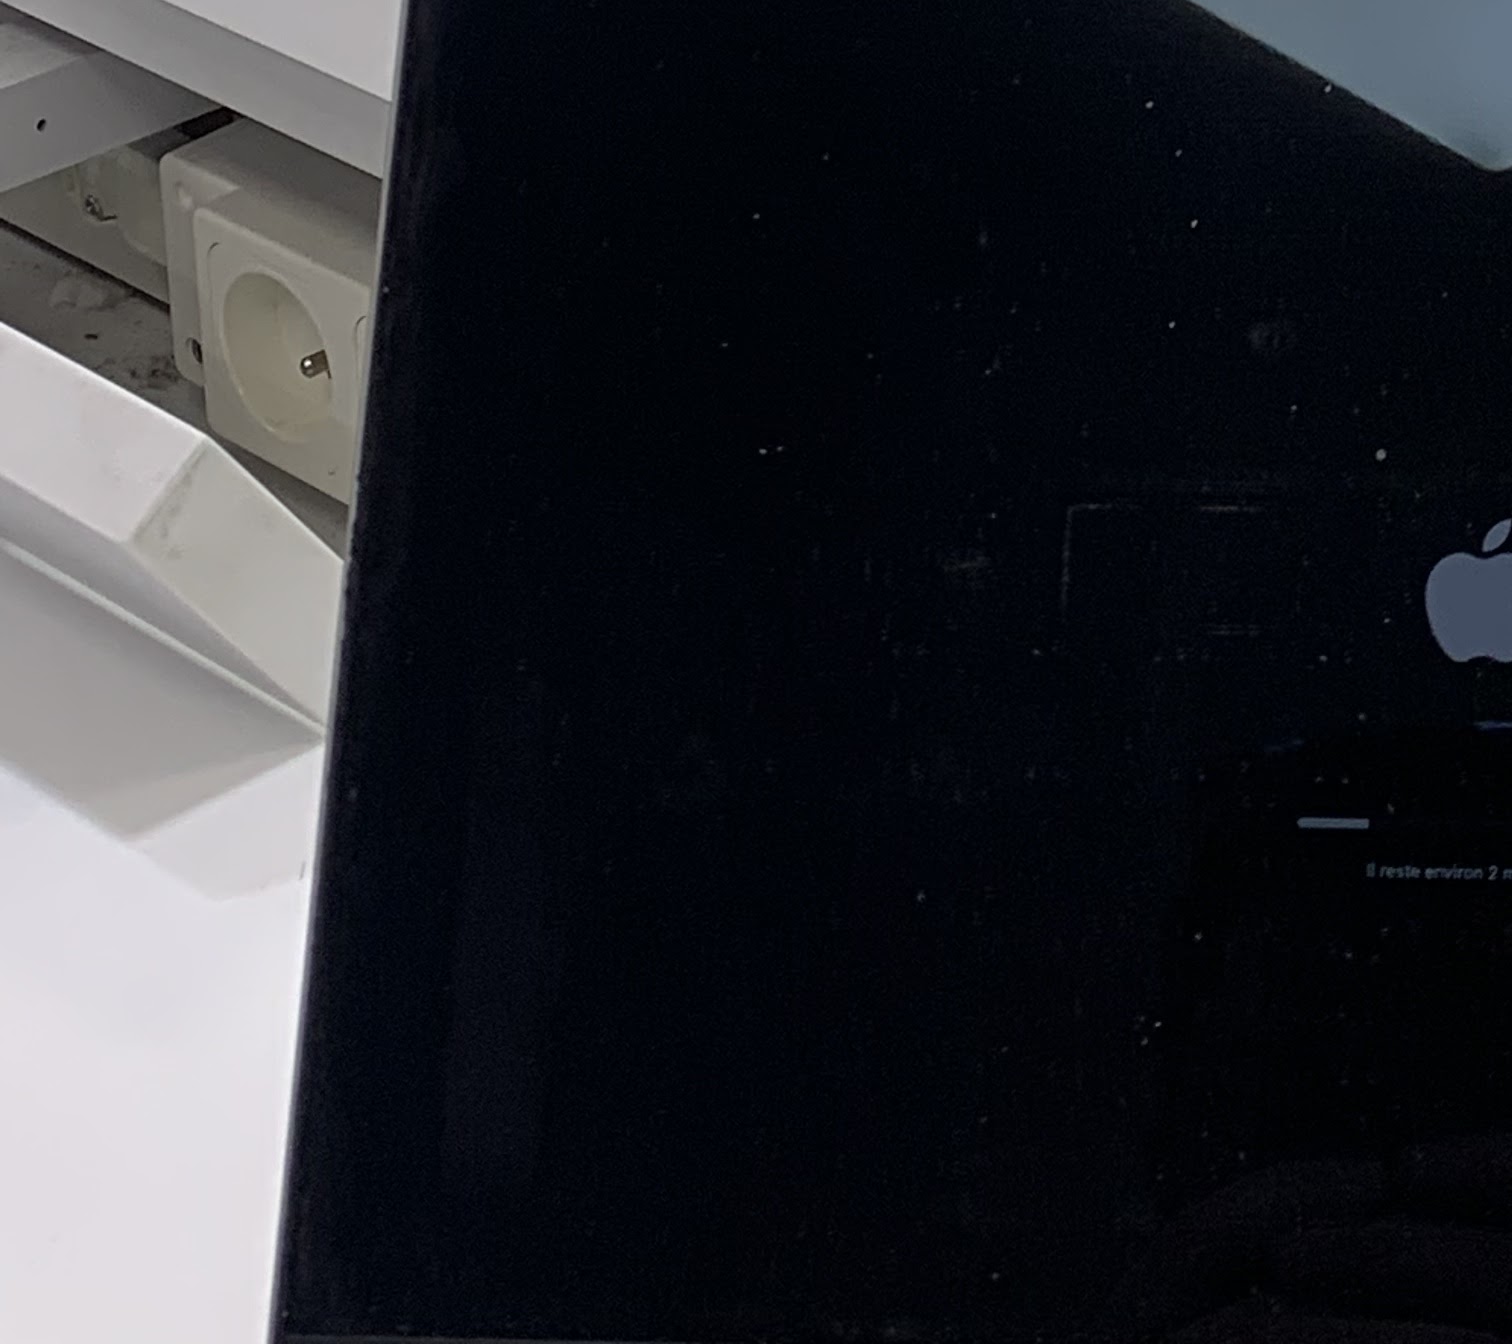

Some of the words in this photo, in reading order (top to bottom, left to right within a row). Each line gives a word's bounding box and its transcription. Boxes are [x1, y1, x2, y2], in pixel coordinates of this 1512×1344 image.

[1379, 863, 1421, 879] reste
[1424, 864, 1484, 880] environ
[1487, 864, 1498, 881] 2
